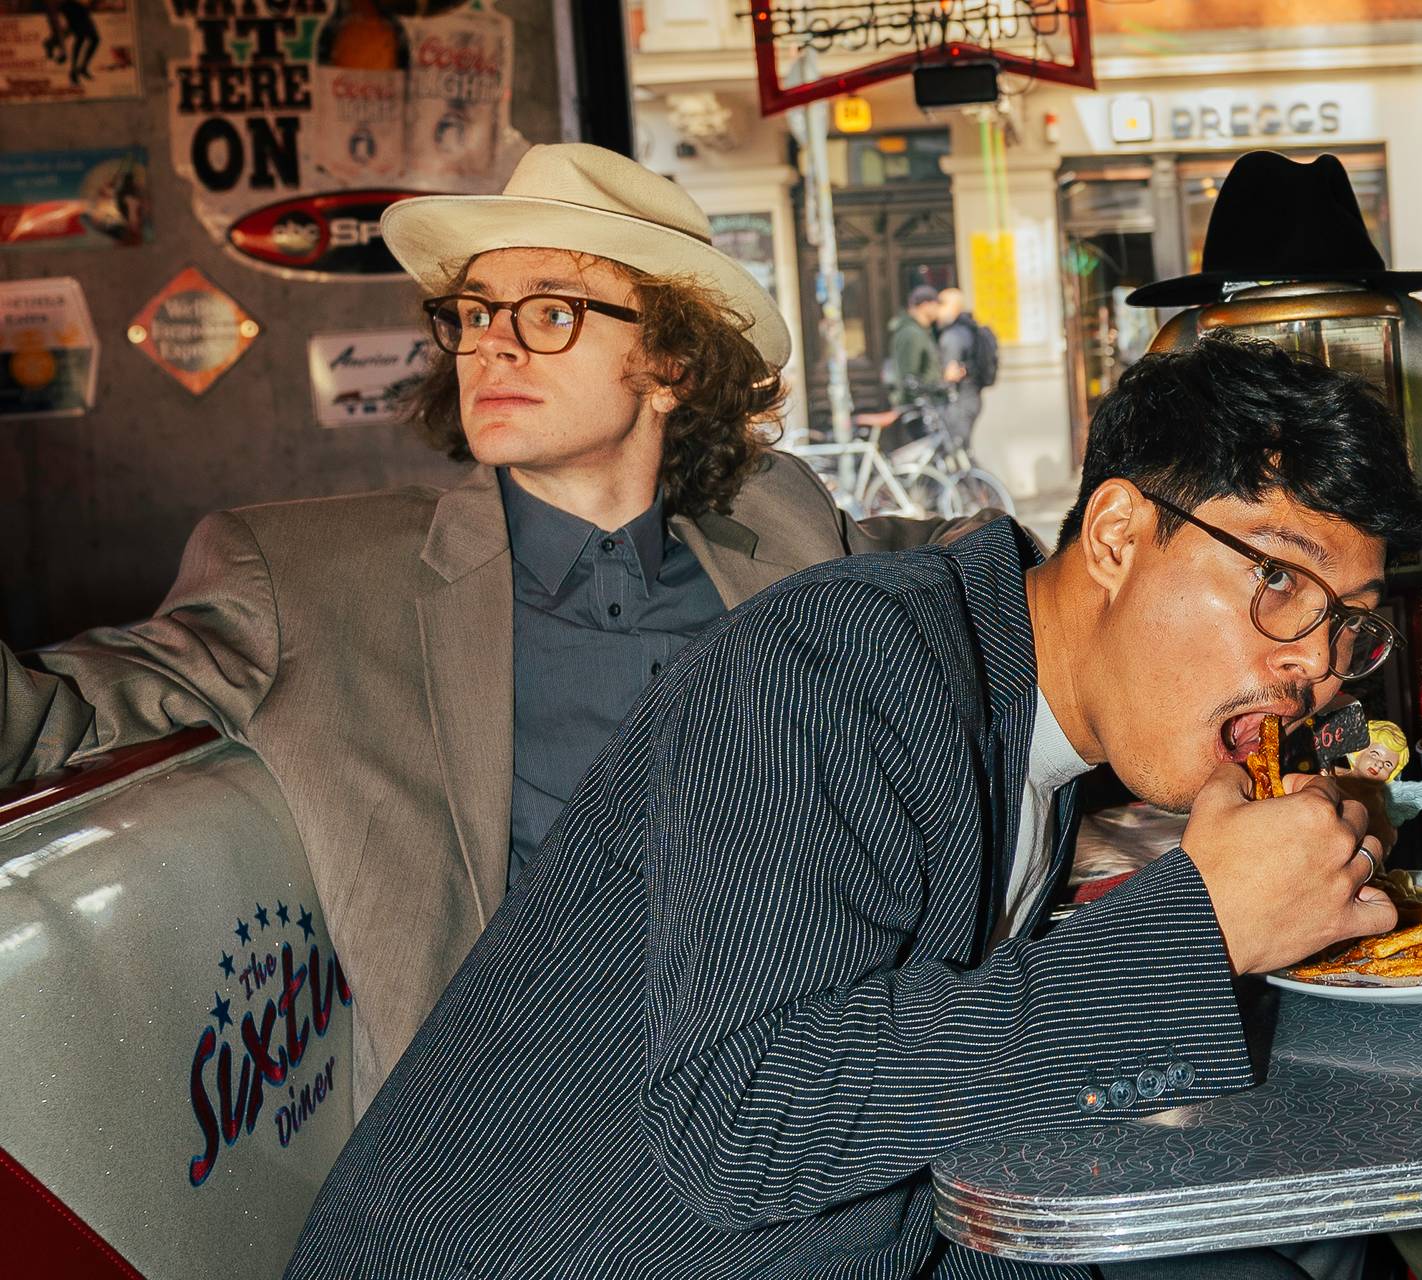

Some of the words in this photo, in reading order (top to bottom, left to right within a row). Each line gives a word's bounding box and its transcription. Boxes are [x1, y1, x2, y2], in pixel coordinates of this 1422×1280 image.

[197, 17, 297, 66] IT
[177, 65, 312, 117] HERE
[191, 116, 301, 193] ON
[239, 951, 278, 1000] The
[276, 1056, 336, 1148] Diner
